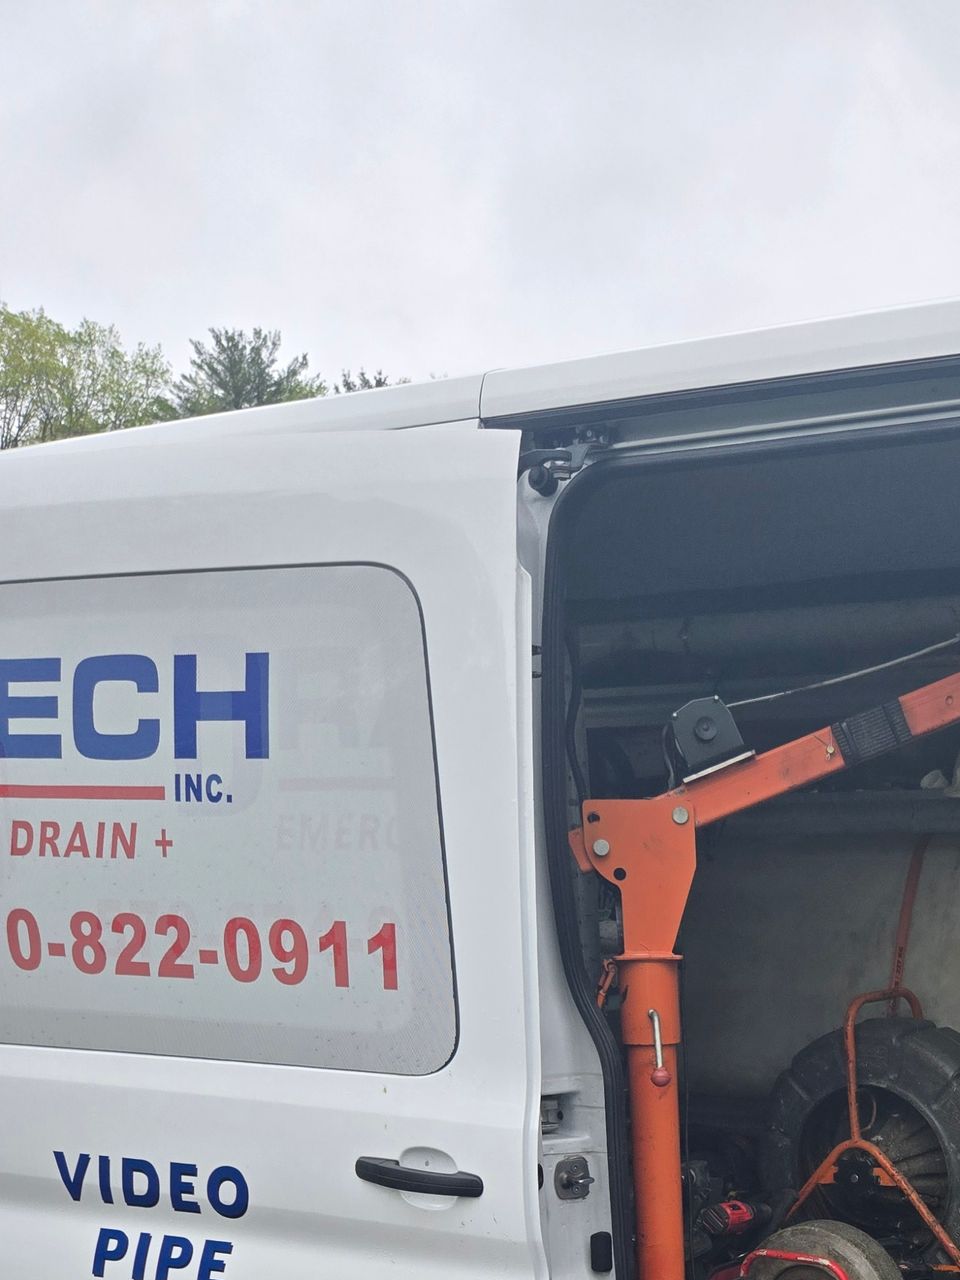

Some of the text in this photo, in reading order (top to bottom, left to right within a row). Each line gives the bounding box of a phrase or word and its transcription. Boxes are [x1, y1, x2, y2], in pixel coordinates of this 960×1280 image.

[0, 652, 270, 760] ECH
[174, 773, 233, 804] INC.
[10, 819, 138, 860] DRAIN
[6, 907, 399, 991] 0-822-0911
[53, 1150, 250, 1218] VIDEO
